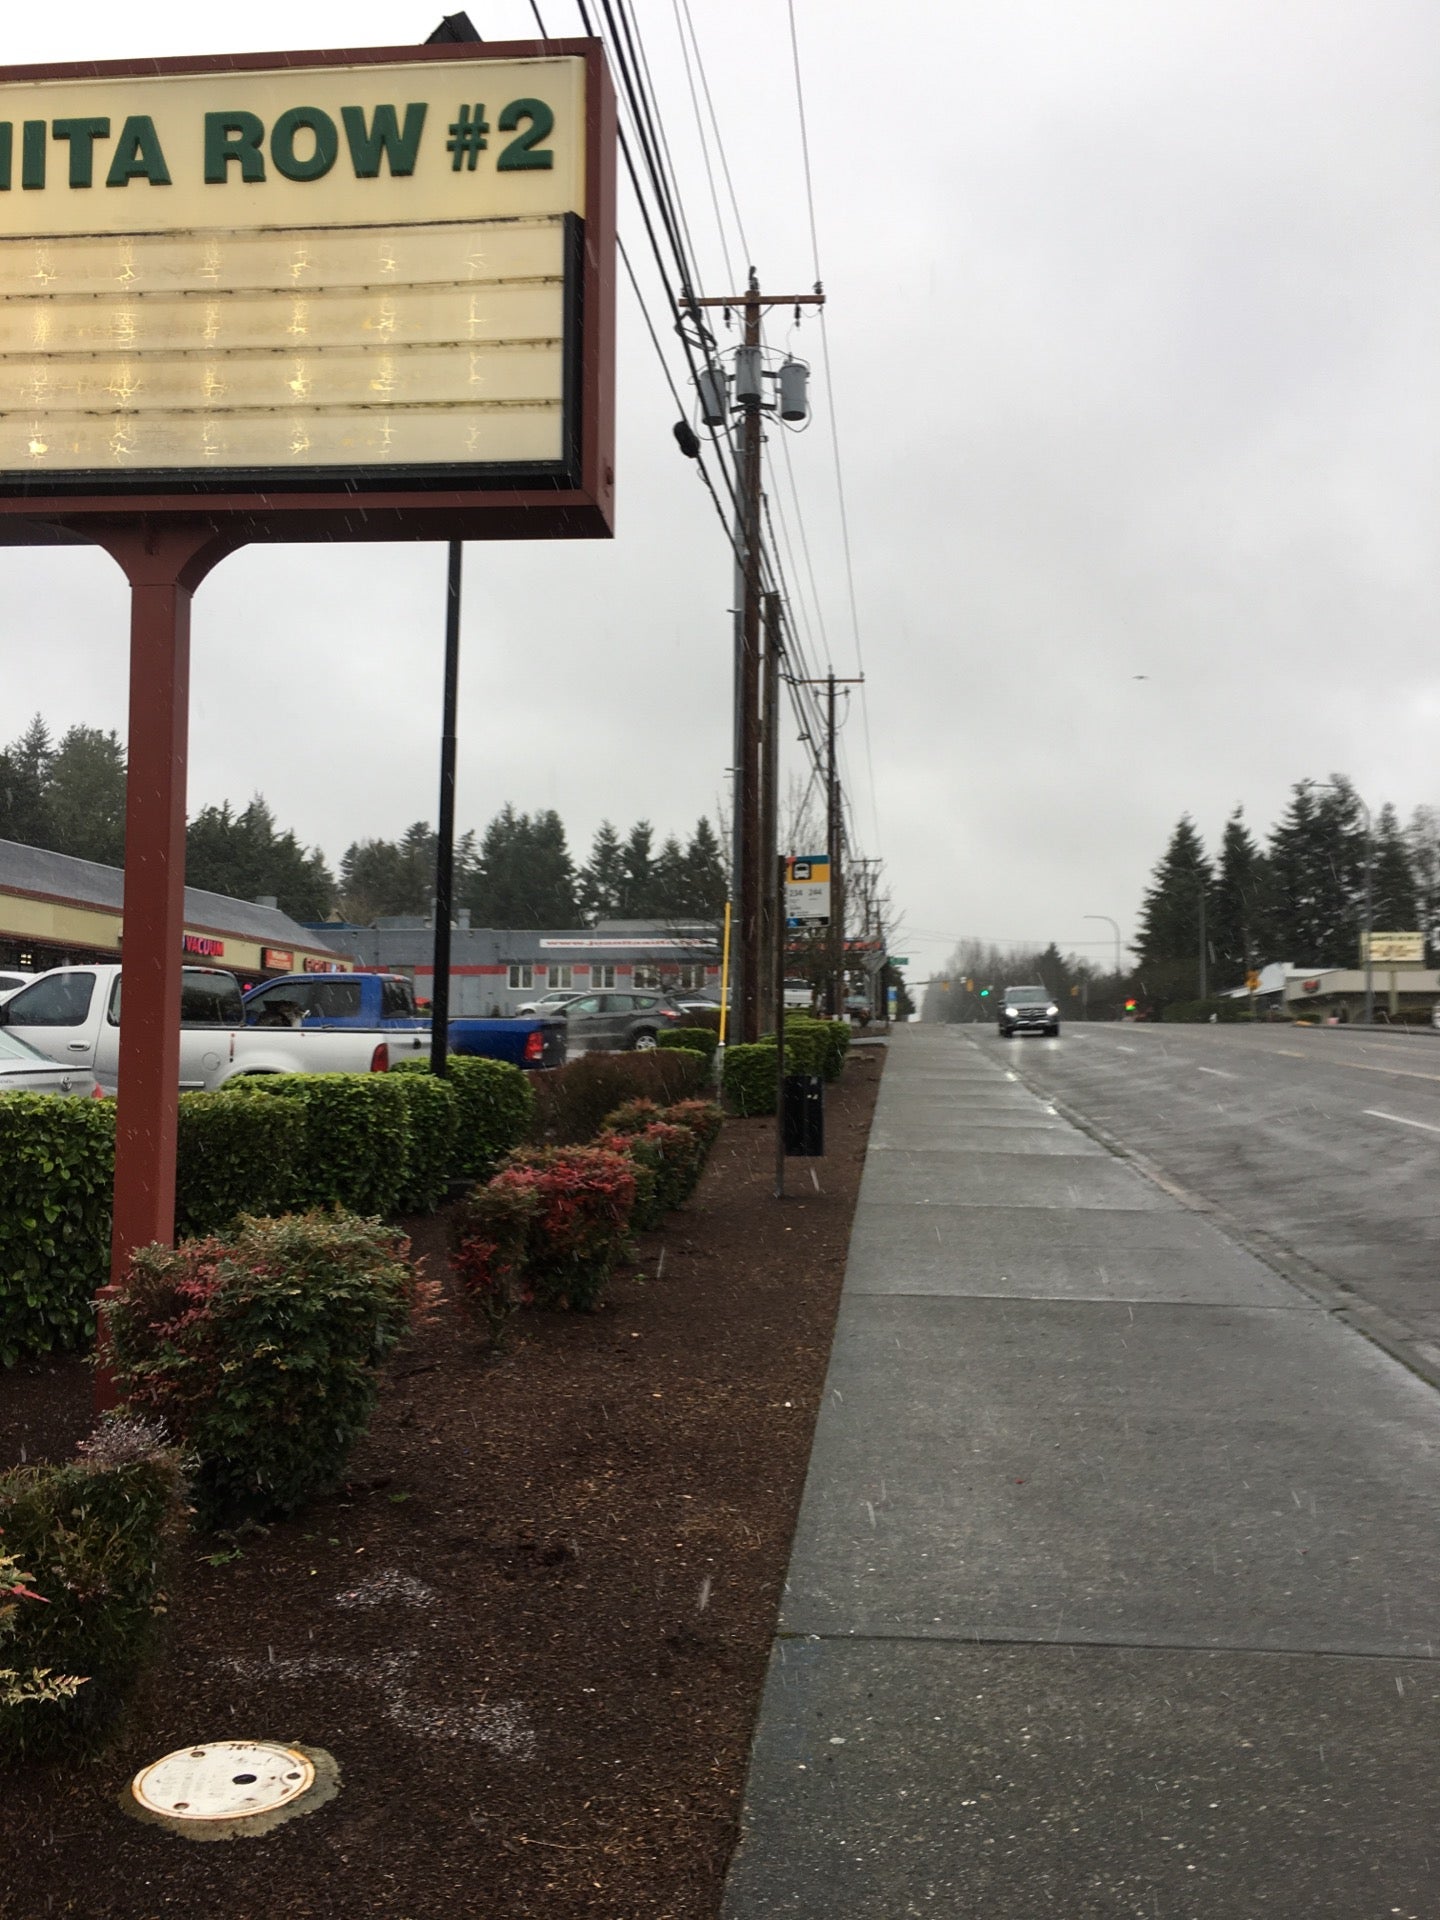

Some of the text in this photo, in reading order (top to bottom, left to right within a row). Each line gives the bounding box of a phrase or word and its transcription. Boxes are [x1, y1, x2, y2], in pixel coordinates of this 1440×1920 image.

[0, 98, 555, 191] ITA ROW #2
[186, 935, 224, 956] VACUUM
